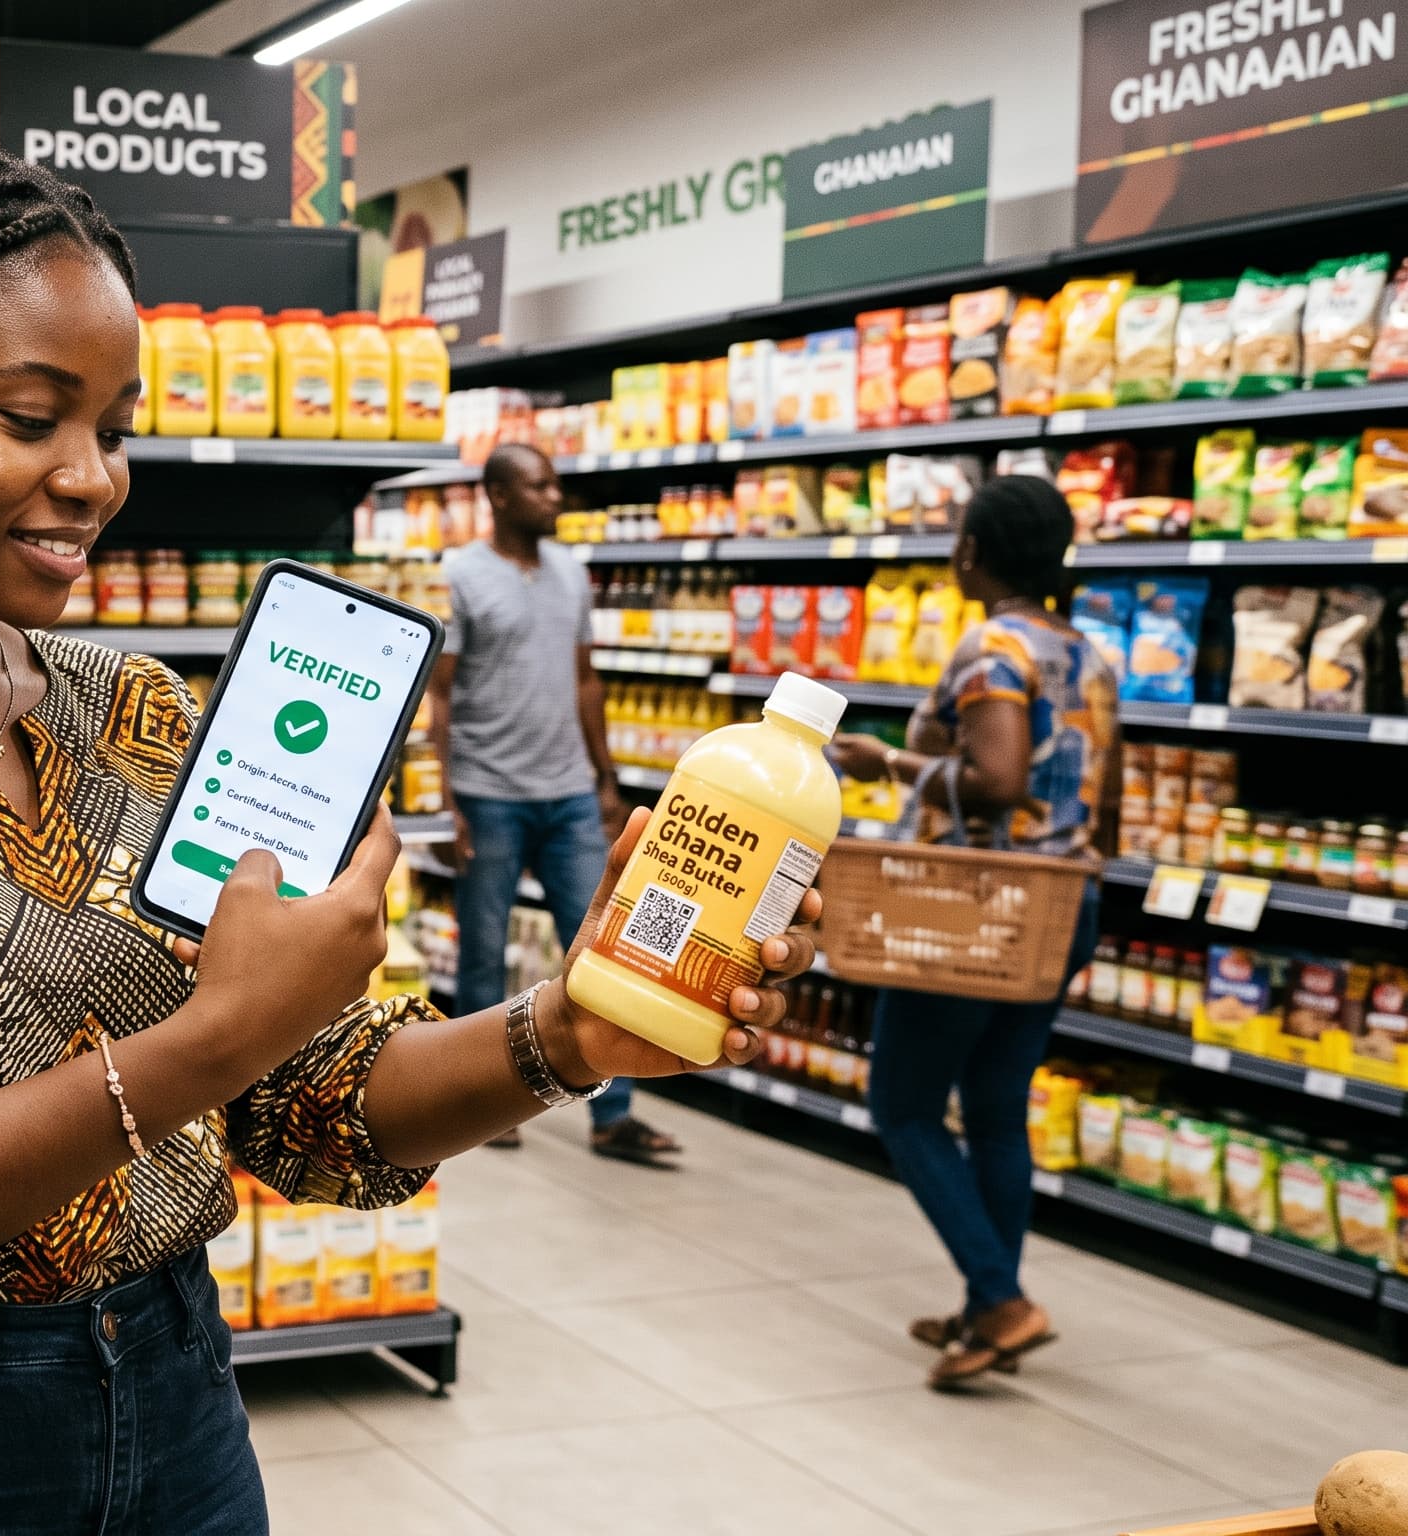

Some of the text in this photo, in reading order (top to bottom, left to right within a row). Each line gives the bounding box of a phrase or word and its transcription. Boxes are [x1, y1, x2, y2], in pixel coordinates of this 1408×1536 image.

[1110, 12, 1397, 123] GHANAAIAN
[73, 85, 221, 133] LOCAL
[24, 128, 268, 181] PRODUCTS
[813, 132, 954, 196] GHANAIAN
[558, 171, 712, 252] FRESHLY
[269, 640, 381, 701] VERIFIED
[237, 760, 331, 804] Origin: Accra, Ghana
[214, 816, 239, 832] Farm
[240, 826, 251, 837] to
[227, 789, 316, 831] Certified Authentic
[667, 794, 760, 852] Golden
[642, 840, 678, 868] Shea
[680, 857, 746, 899] Butter
[659, 820, 742, 873] Ghana
[657, 868, 698, 897] (500g)
